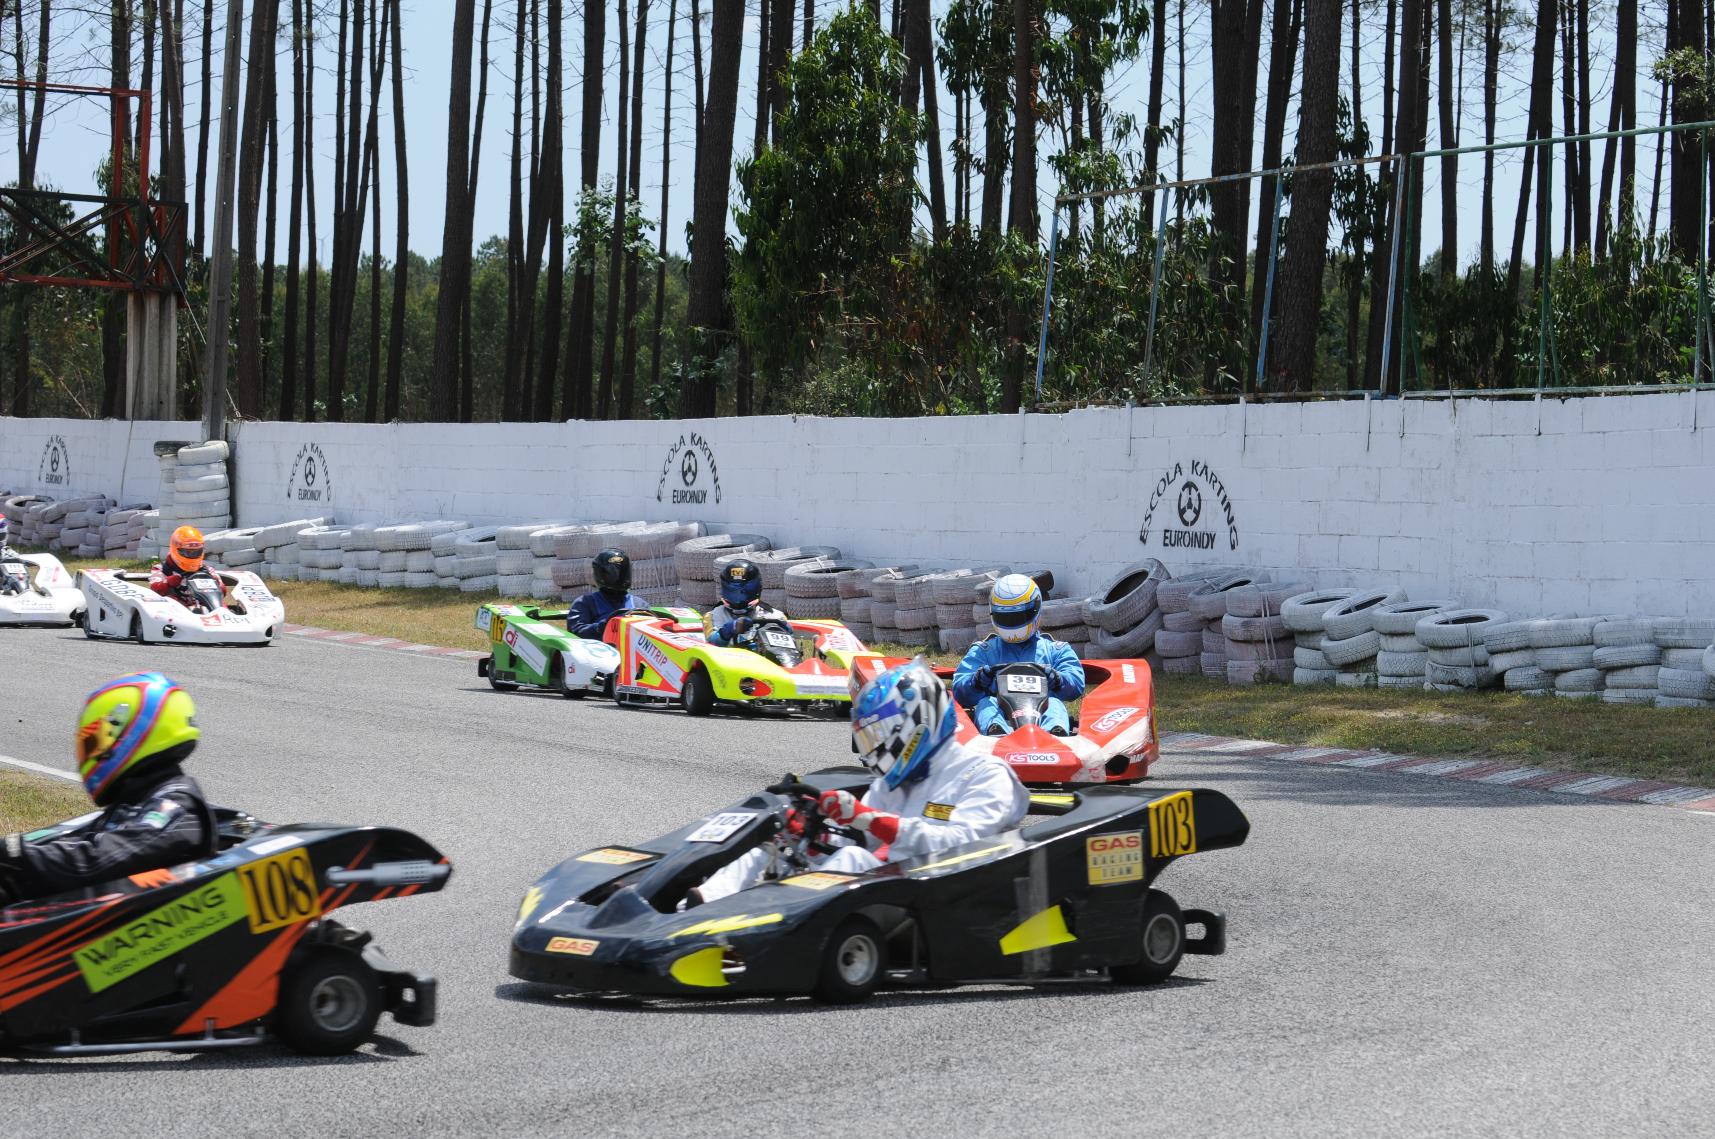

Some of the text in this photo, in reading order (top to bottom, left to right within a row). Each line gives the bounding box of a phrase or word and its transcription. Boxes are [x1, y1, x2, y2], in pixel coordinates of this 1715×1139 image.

[658, 432, 722, 504] ESCOLA KARTING
[672, 489, 708, 504] EUROINDY
[1140, 459, 1239, 551] ESCOLA KARTING
[1162, 529, 1216, 550] EUROINDY
[637, 633, 668, 666] UNITRIP
[1012, 675, 1037, 684] 39
[1094, 718, 1116, 731] KS
[1009, 753, 1027, 763] KS
[1154, 797, 1193, 858] 103
[1090, 835, 1140, 852] GAS
[244, 855, 314, 927] 108
[82, 886, 226, 966] WARNING
[551, 939, 594, 953] GAS
